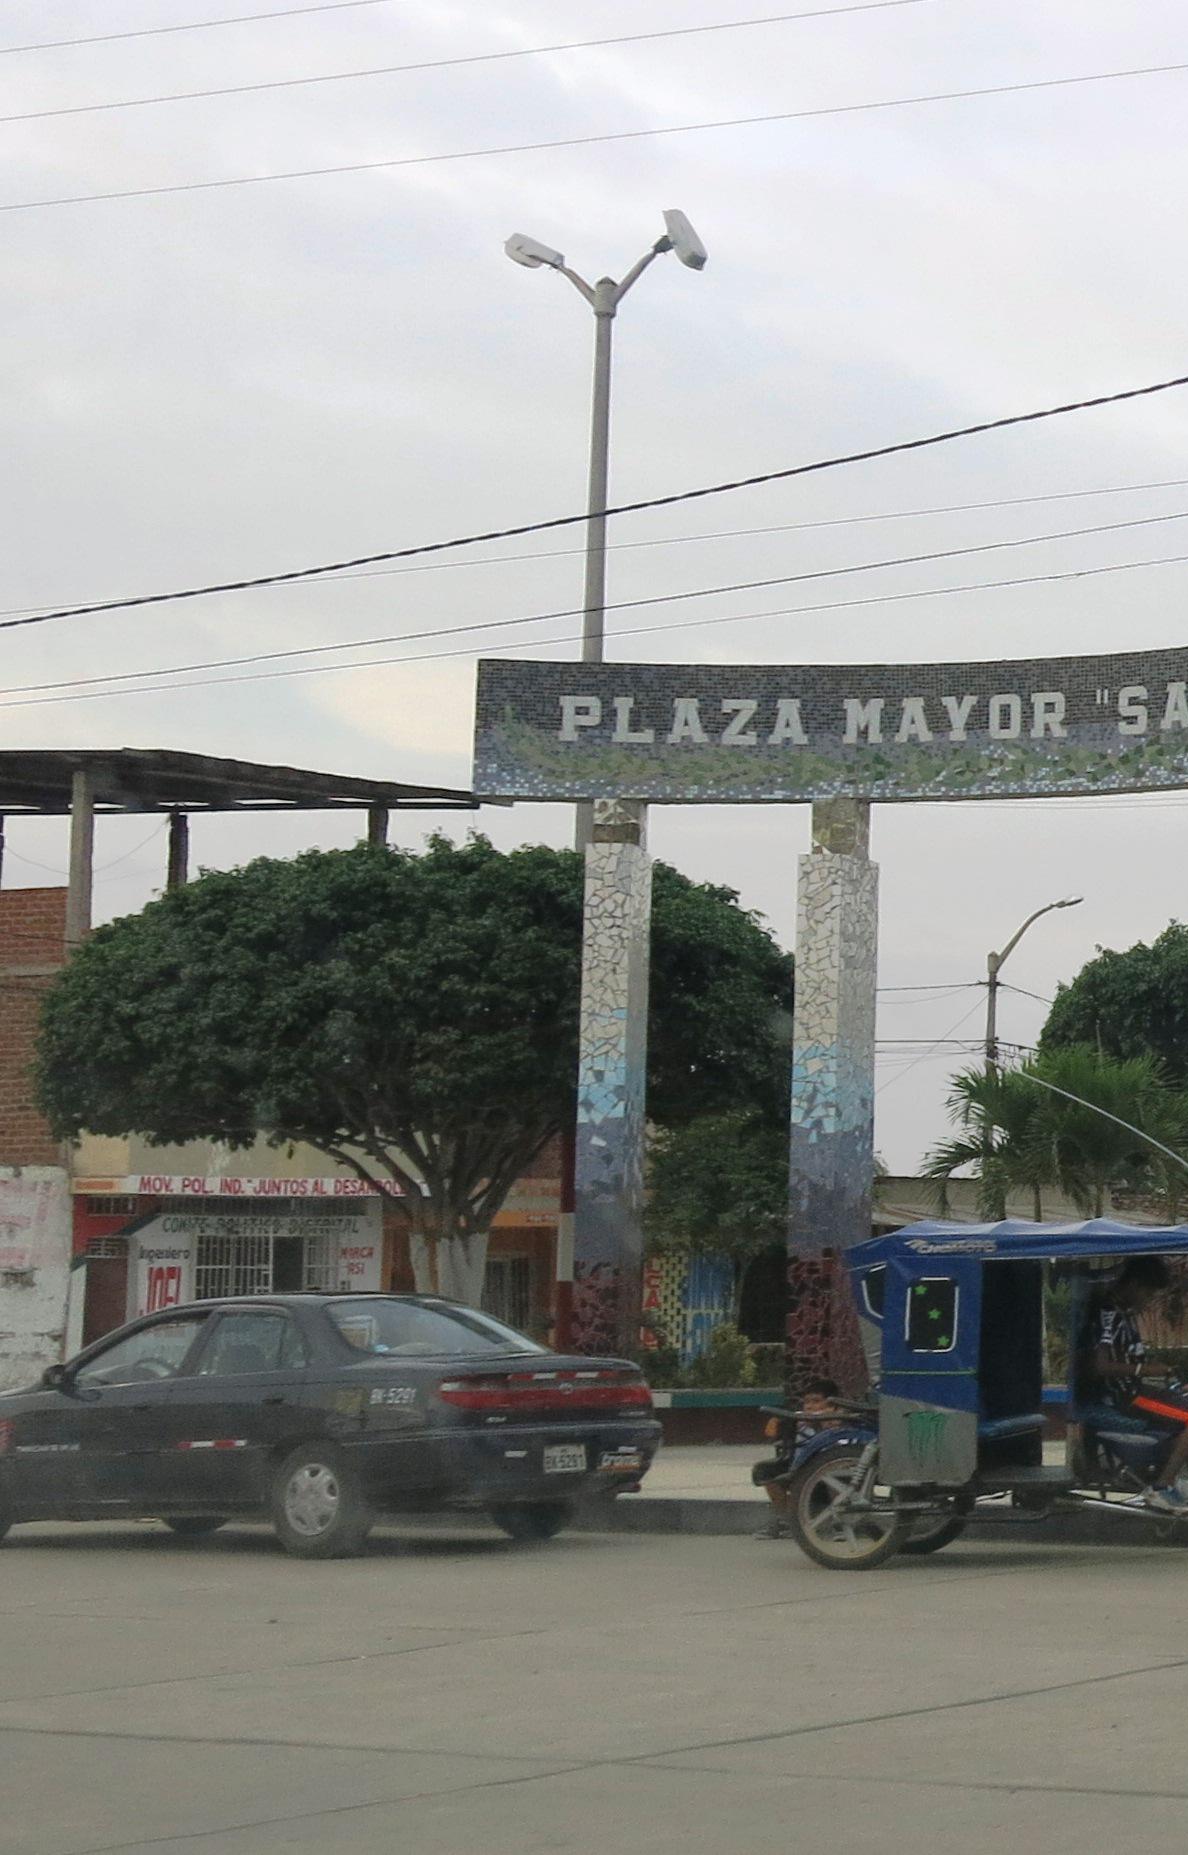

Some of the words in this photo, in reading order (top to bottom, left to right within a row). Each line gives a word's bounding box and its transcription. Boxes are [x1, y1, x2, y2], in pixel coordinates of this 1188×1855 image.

[558, 695, 808, 746] PLAZA
[842, 691, 1067, 744] MAYOR
[139, 1177, 173, 1193] MOV.
[181, 1178, 214, 1194] POL.
[220, 1179, 244, 1194] IND.
[312, 1180, 326, 1195] AL
